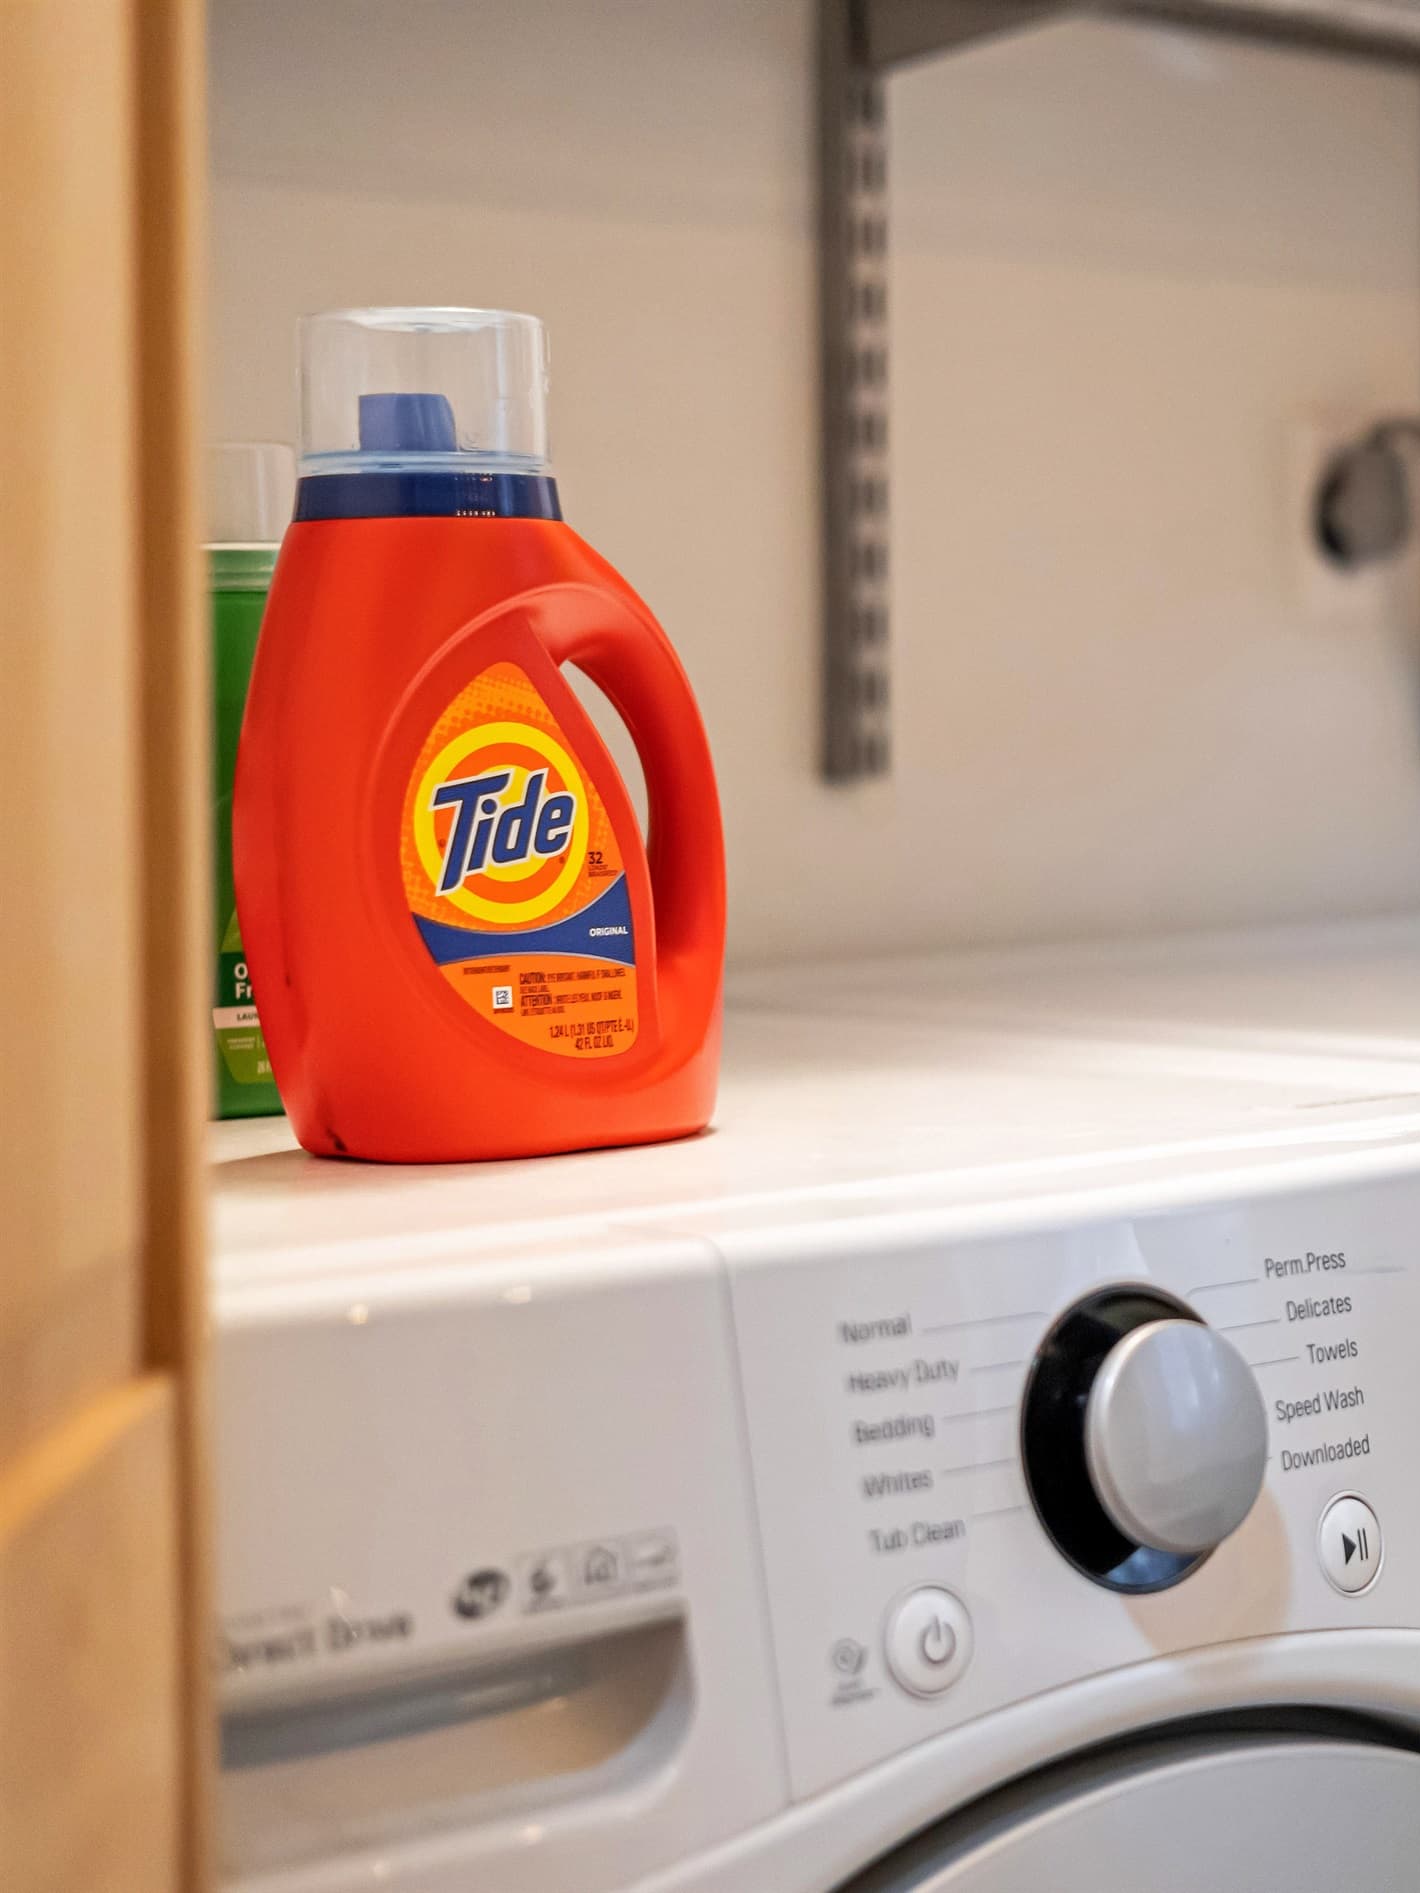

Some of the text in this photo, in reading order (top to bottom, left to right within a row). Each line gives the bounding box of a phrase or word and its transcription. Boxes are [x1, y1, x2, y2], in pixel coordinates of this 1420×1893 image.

[430, 767, 577, 897] Tide
[588, 851, 603, 865] 32
[589, 926, 628, 937] ORIGINAL
[1264, 1251, 1347, 1278] Perm.Press
[1286, 1296, 1352, 1322] Delicates
[839, 1313, 912, 1343] Normal
[1306, 1339, 1358, 1364] Towels
[848, 1359, 960, 1394] Heavy Duty
[1276, 1386, 1364, 1423] Speed Wash
[854, 1413, 935, 1444] Bedding
[1281, 1434, 1370, 1471] Downloaded
[862, 1469, 932, 1499] Whites
[869, 1519, 966, 1553] Tub Clean
